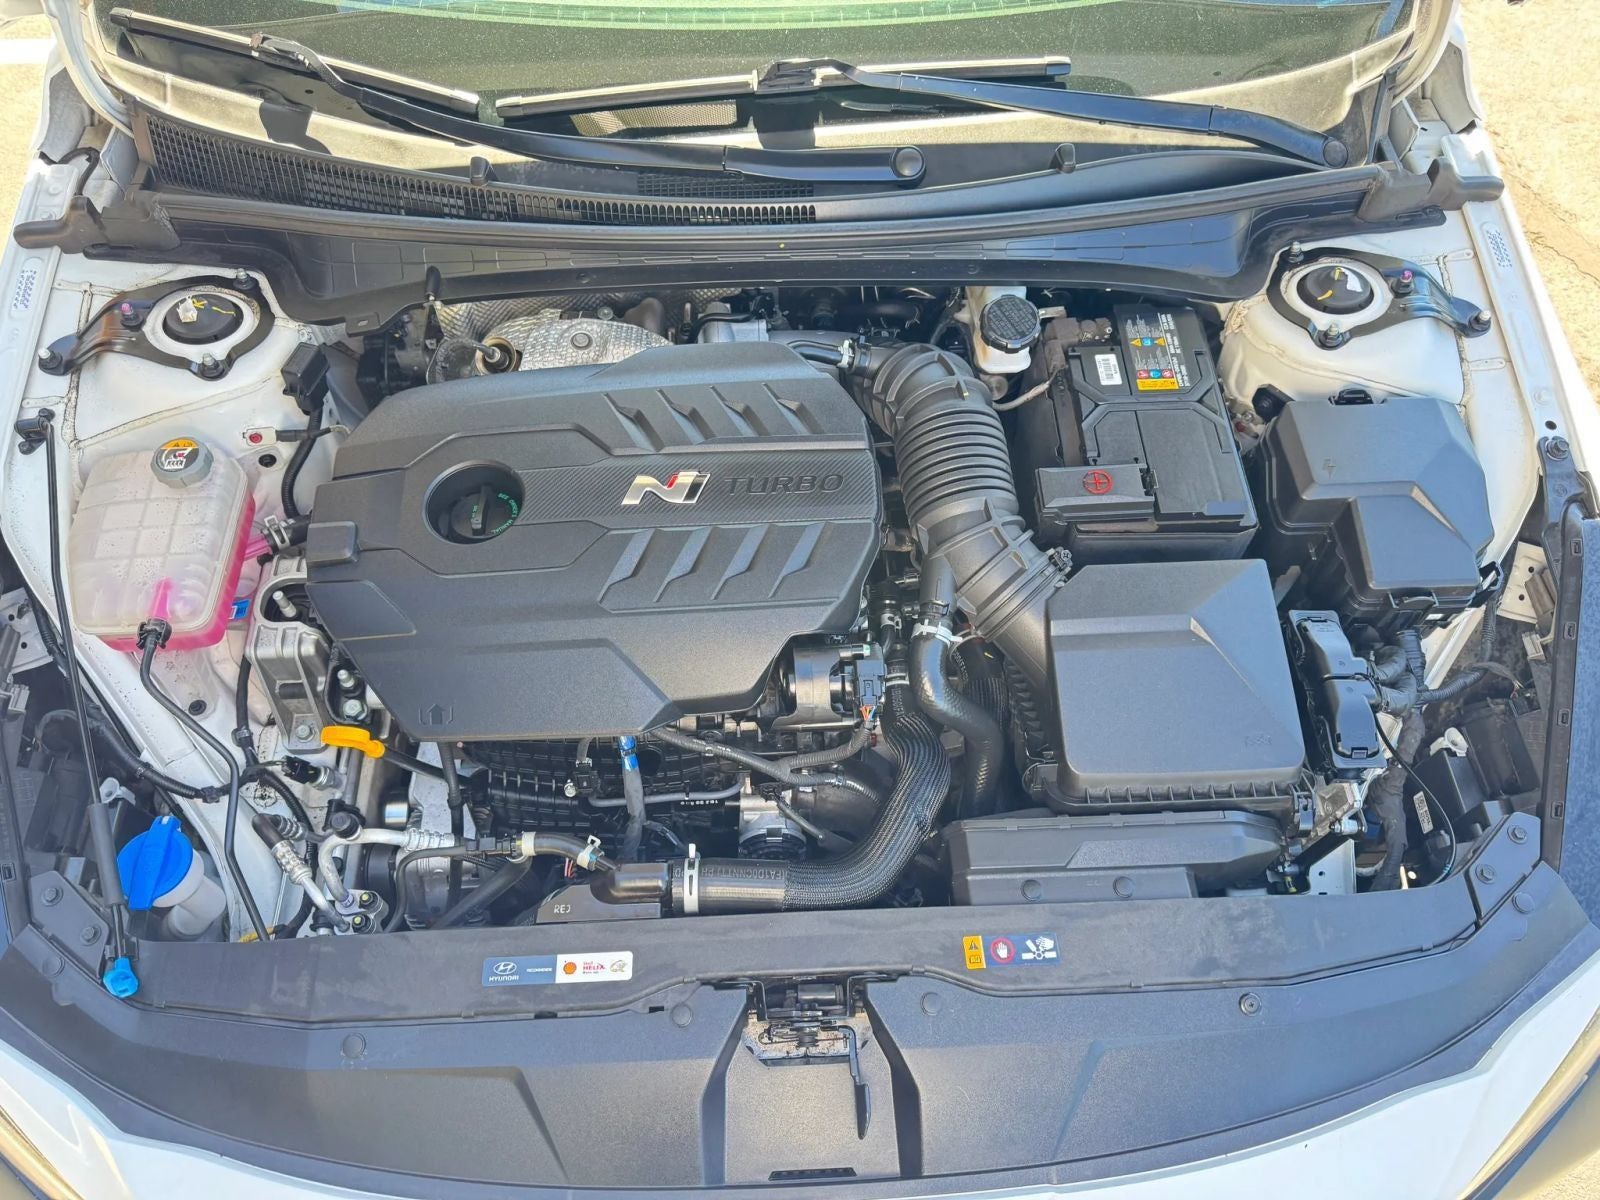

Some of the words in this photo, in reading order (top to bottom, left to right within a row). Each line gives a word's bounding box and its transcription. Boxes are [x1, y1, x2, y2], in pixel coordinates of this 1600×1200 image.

[724, 473, 845, 496] TURBO
[582, 963, 606, 971] HELIX
[488, 975, 520, 983] HYUNDAI
